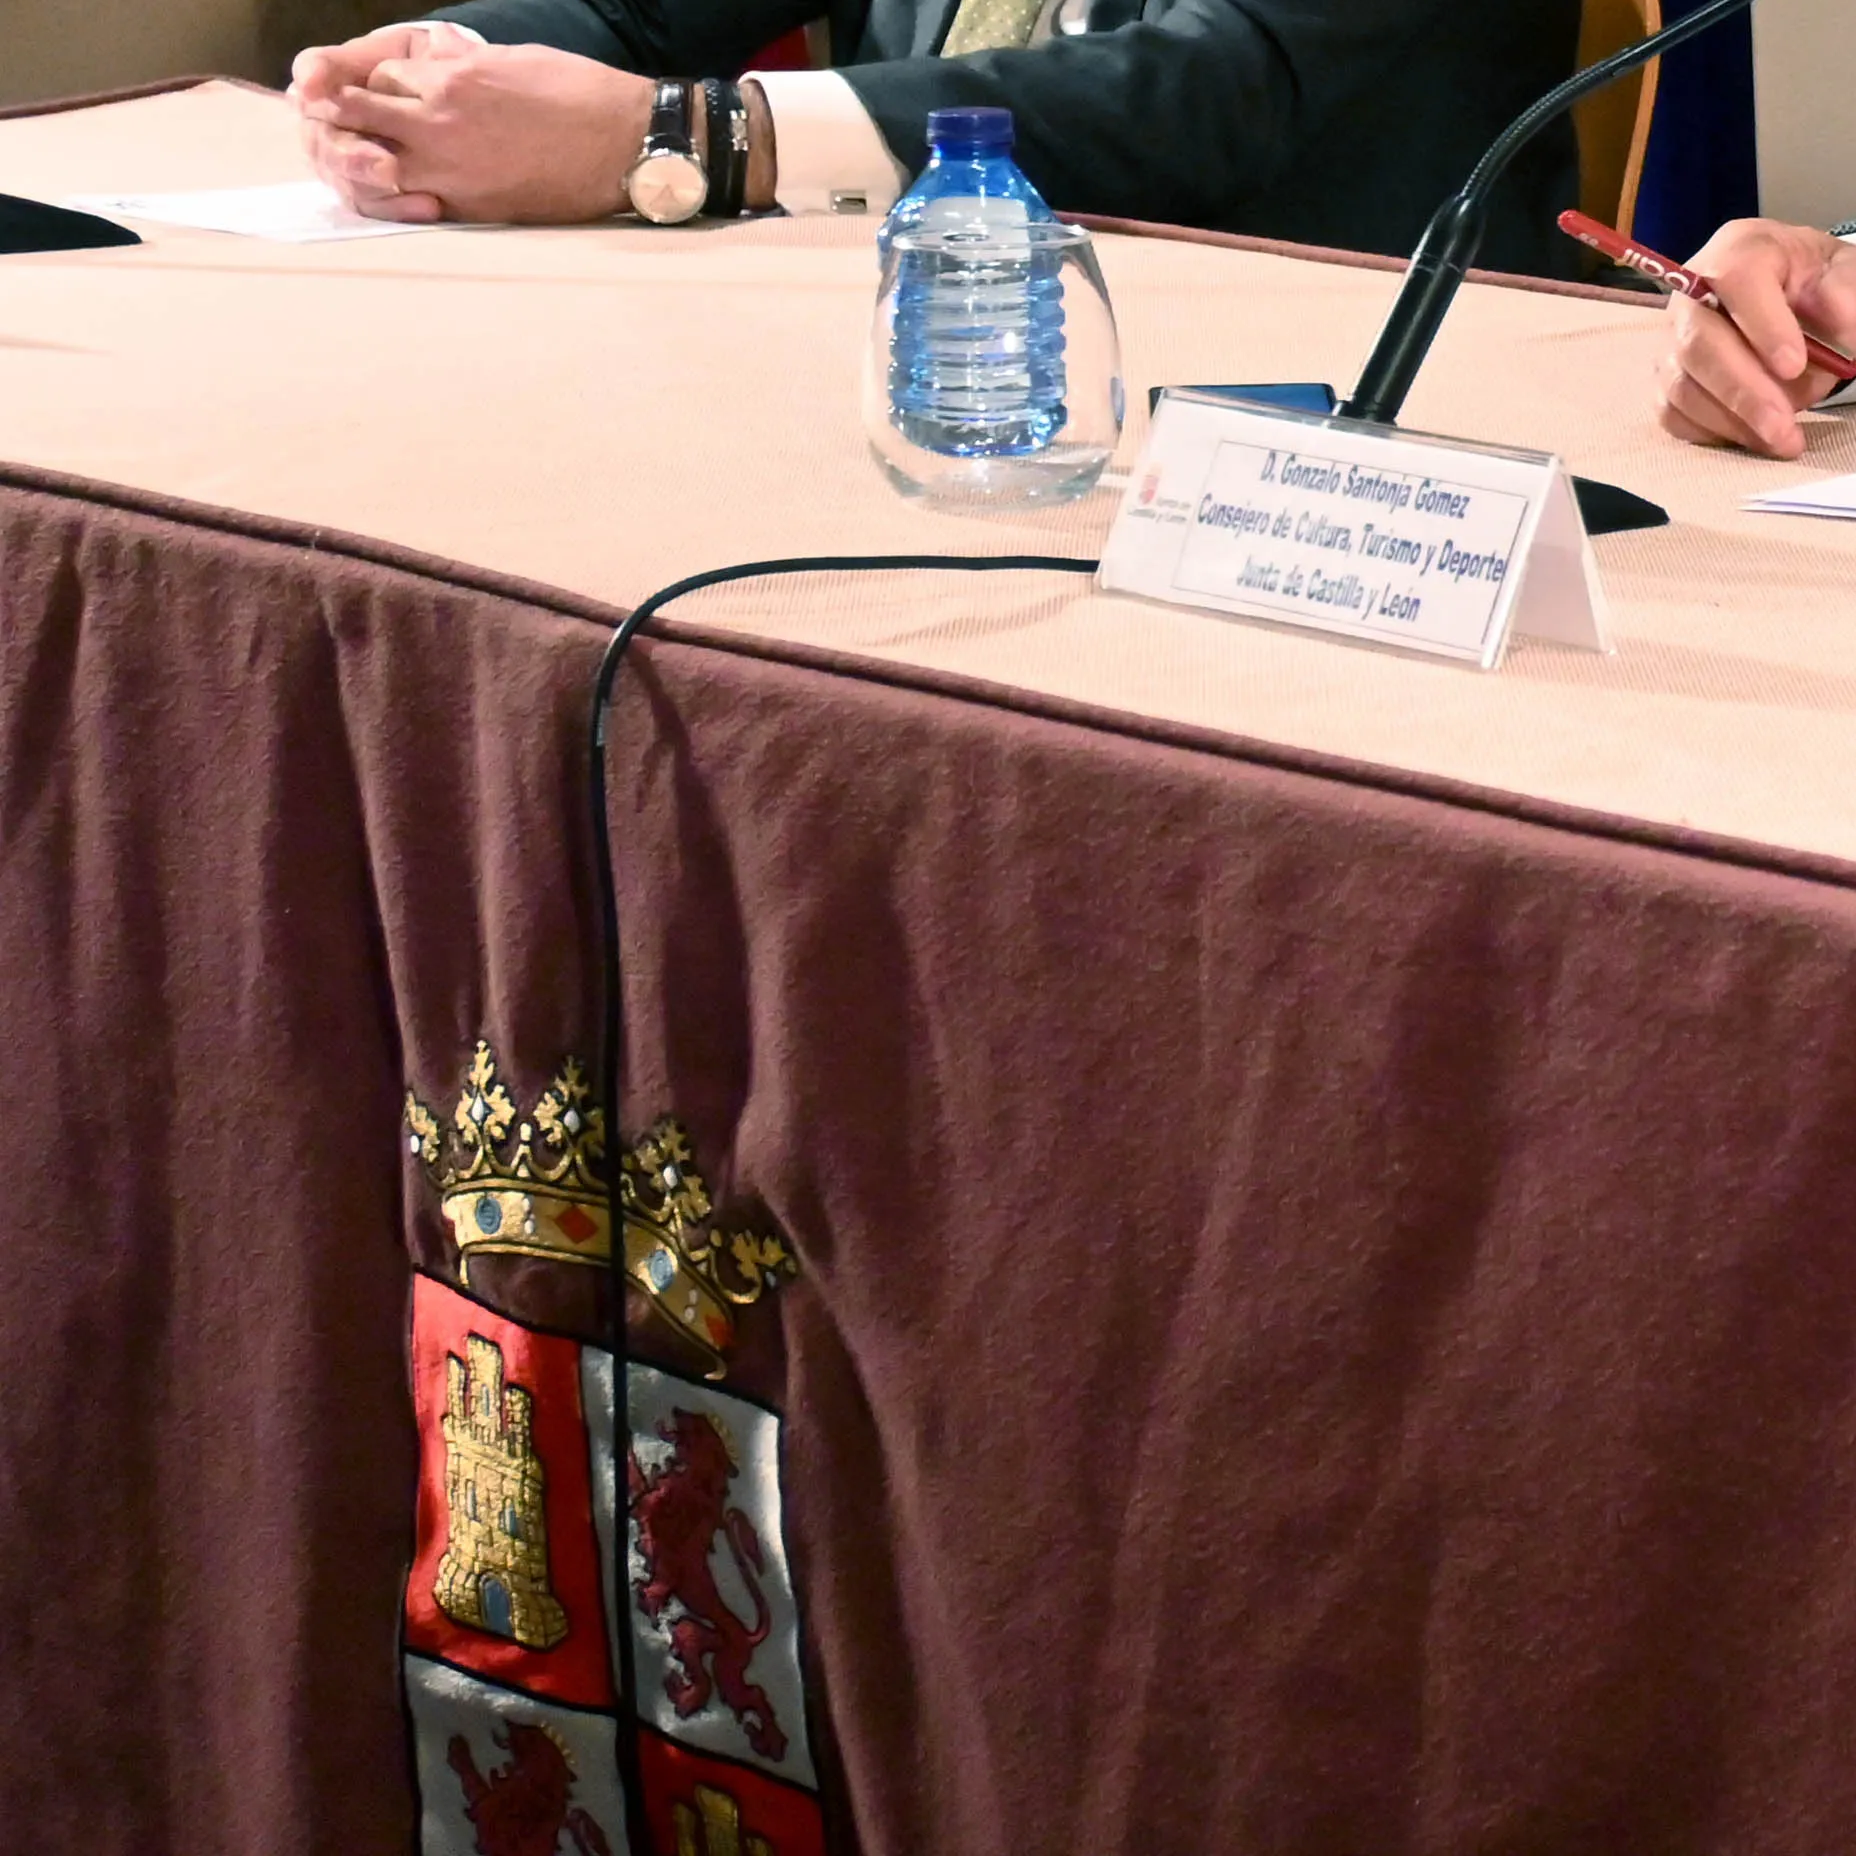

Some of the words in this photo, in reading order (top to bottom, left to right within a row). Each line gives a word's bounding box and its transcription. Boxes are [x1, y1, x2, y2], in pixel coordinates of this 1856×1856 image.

[1260, 451, 1275, 483] D.
[1281, 455, 1341, 494] Gonzalo
[1342, 464, 1411, 513] Santonja
[1197, 493, 1269, 539] Consejero
[1272, 507, 1290, 539] de
[1294, 511, 1351, 558] Cultura,
[1358, 523, 1421, 565] Turismo
[1420, 543, 1438, 576] y
[1438, 539, 1504, 583] Deporte
[1237, 554, 1280, 592] Junta
[1282, 565, 1304, 597] de
[1306, 569, 1362, 610] Castilla
[1362, 588, 1380, 621] y
[1379, 583, 1422, 622] León
